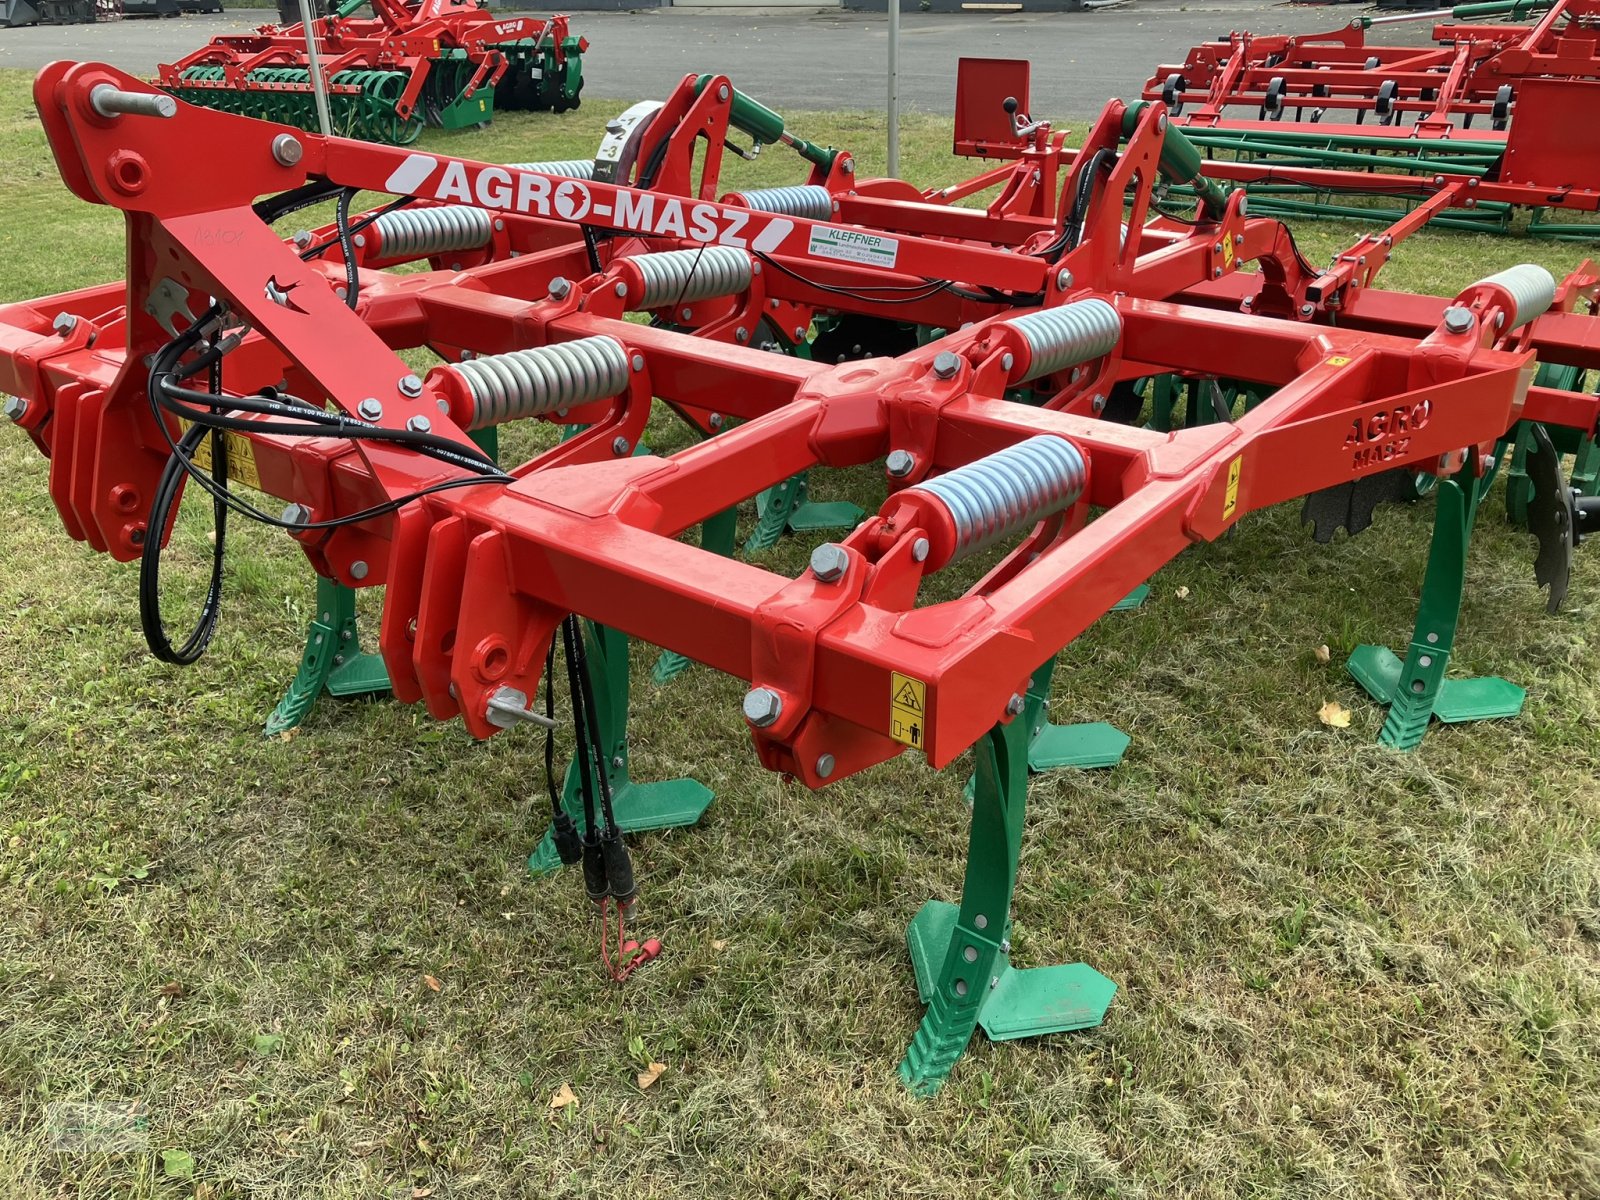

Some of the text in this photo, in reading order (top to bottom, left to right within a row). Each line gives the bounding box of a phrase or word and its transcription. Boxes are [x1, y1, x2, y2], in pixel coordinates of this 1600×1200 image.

[434, 161, 751, 249] AGRO-MASZ
[828, 229, 881, 246] KLEFFNER
[288, 405, 302, 413] SAE
[1341, 399, 1434, 451] AGRO
[1351, 436, 1411, 471] MASZ
